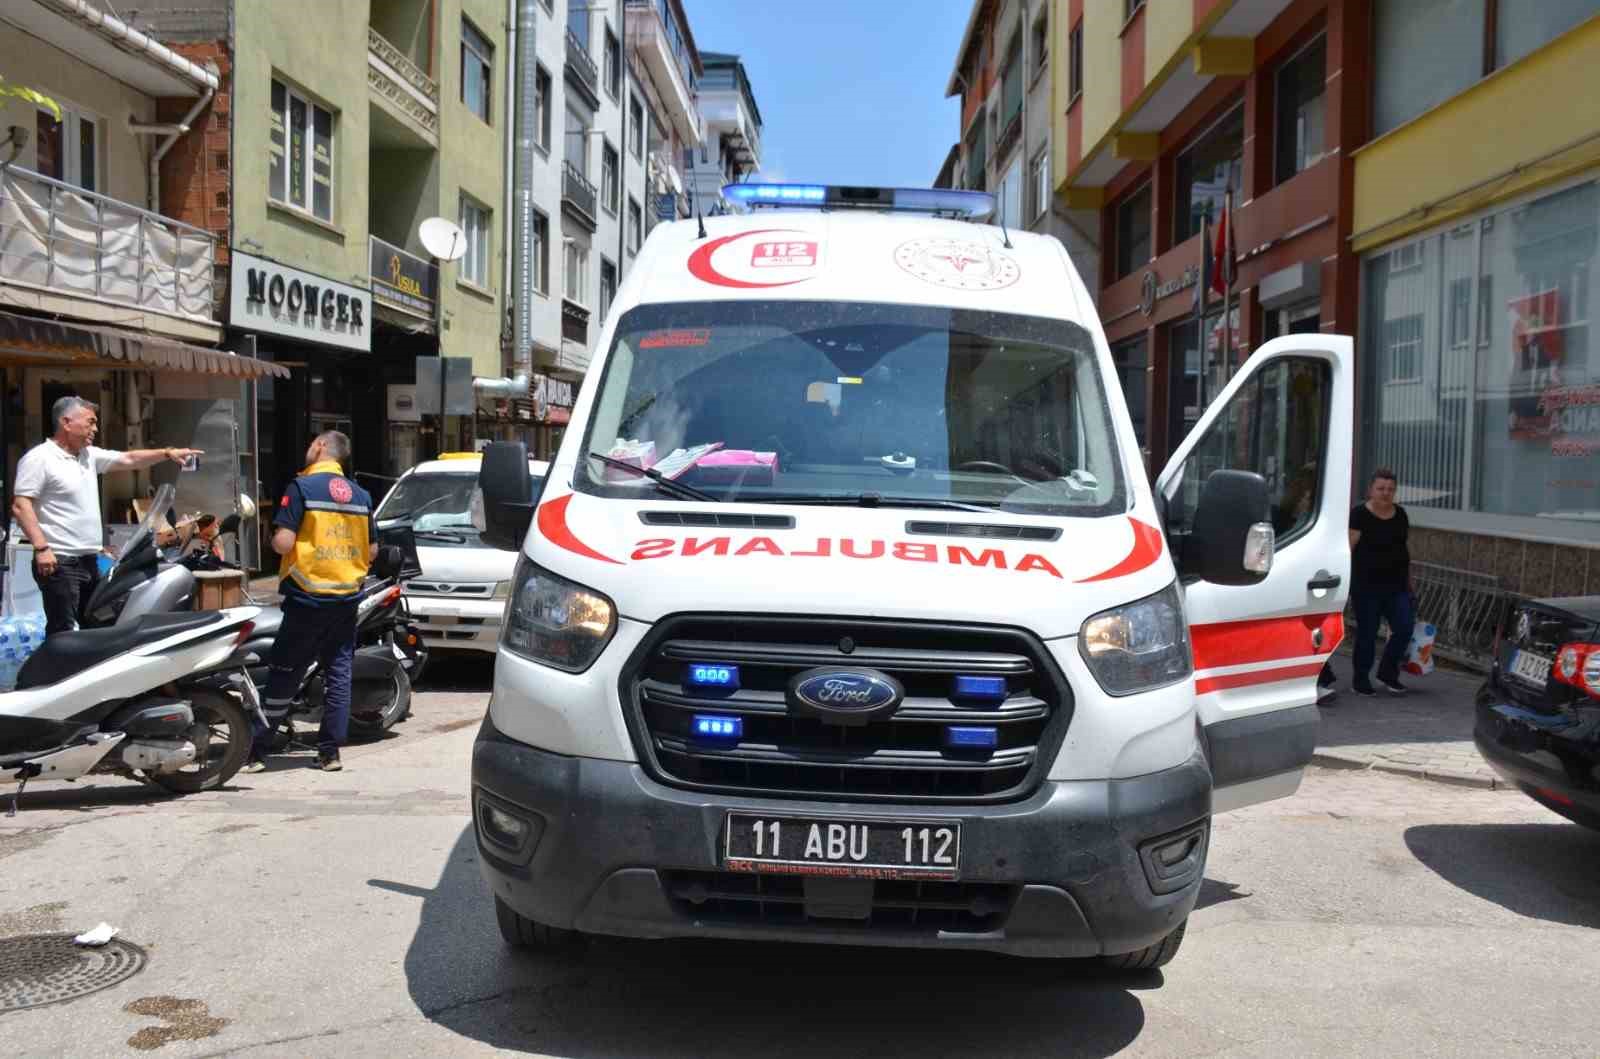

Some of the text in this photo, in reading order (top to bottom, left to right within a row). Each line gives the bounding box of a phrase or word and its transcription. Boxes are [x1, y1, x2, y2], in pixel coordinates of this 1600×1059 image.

[763, 243, 808, 257] 112
[818, 680, 873, 702] Ford
[752, 820, 953, 864] 11 ABU 112
